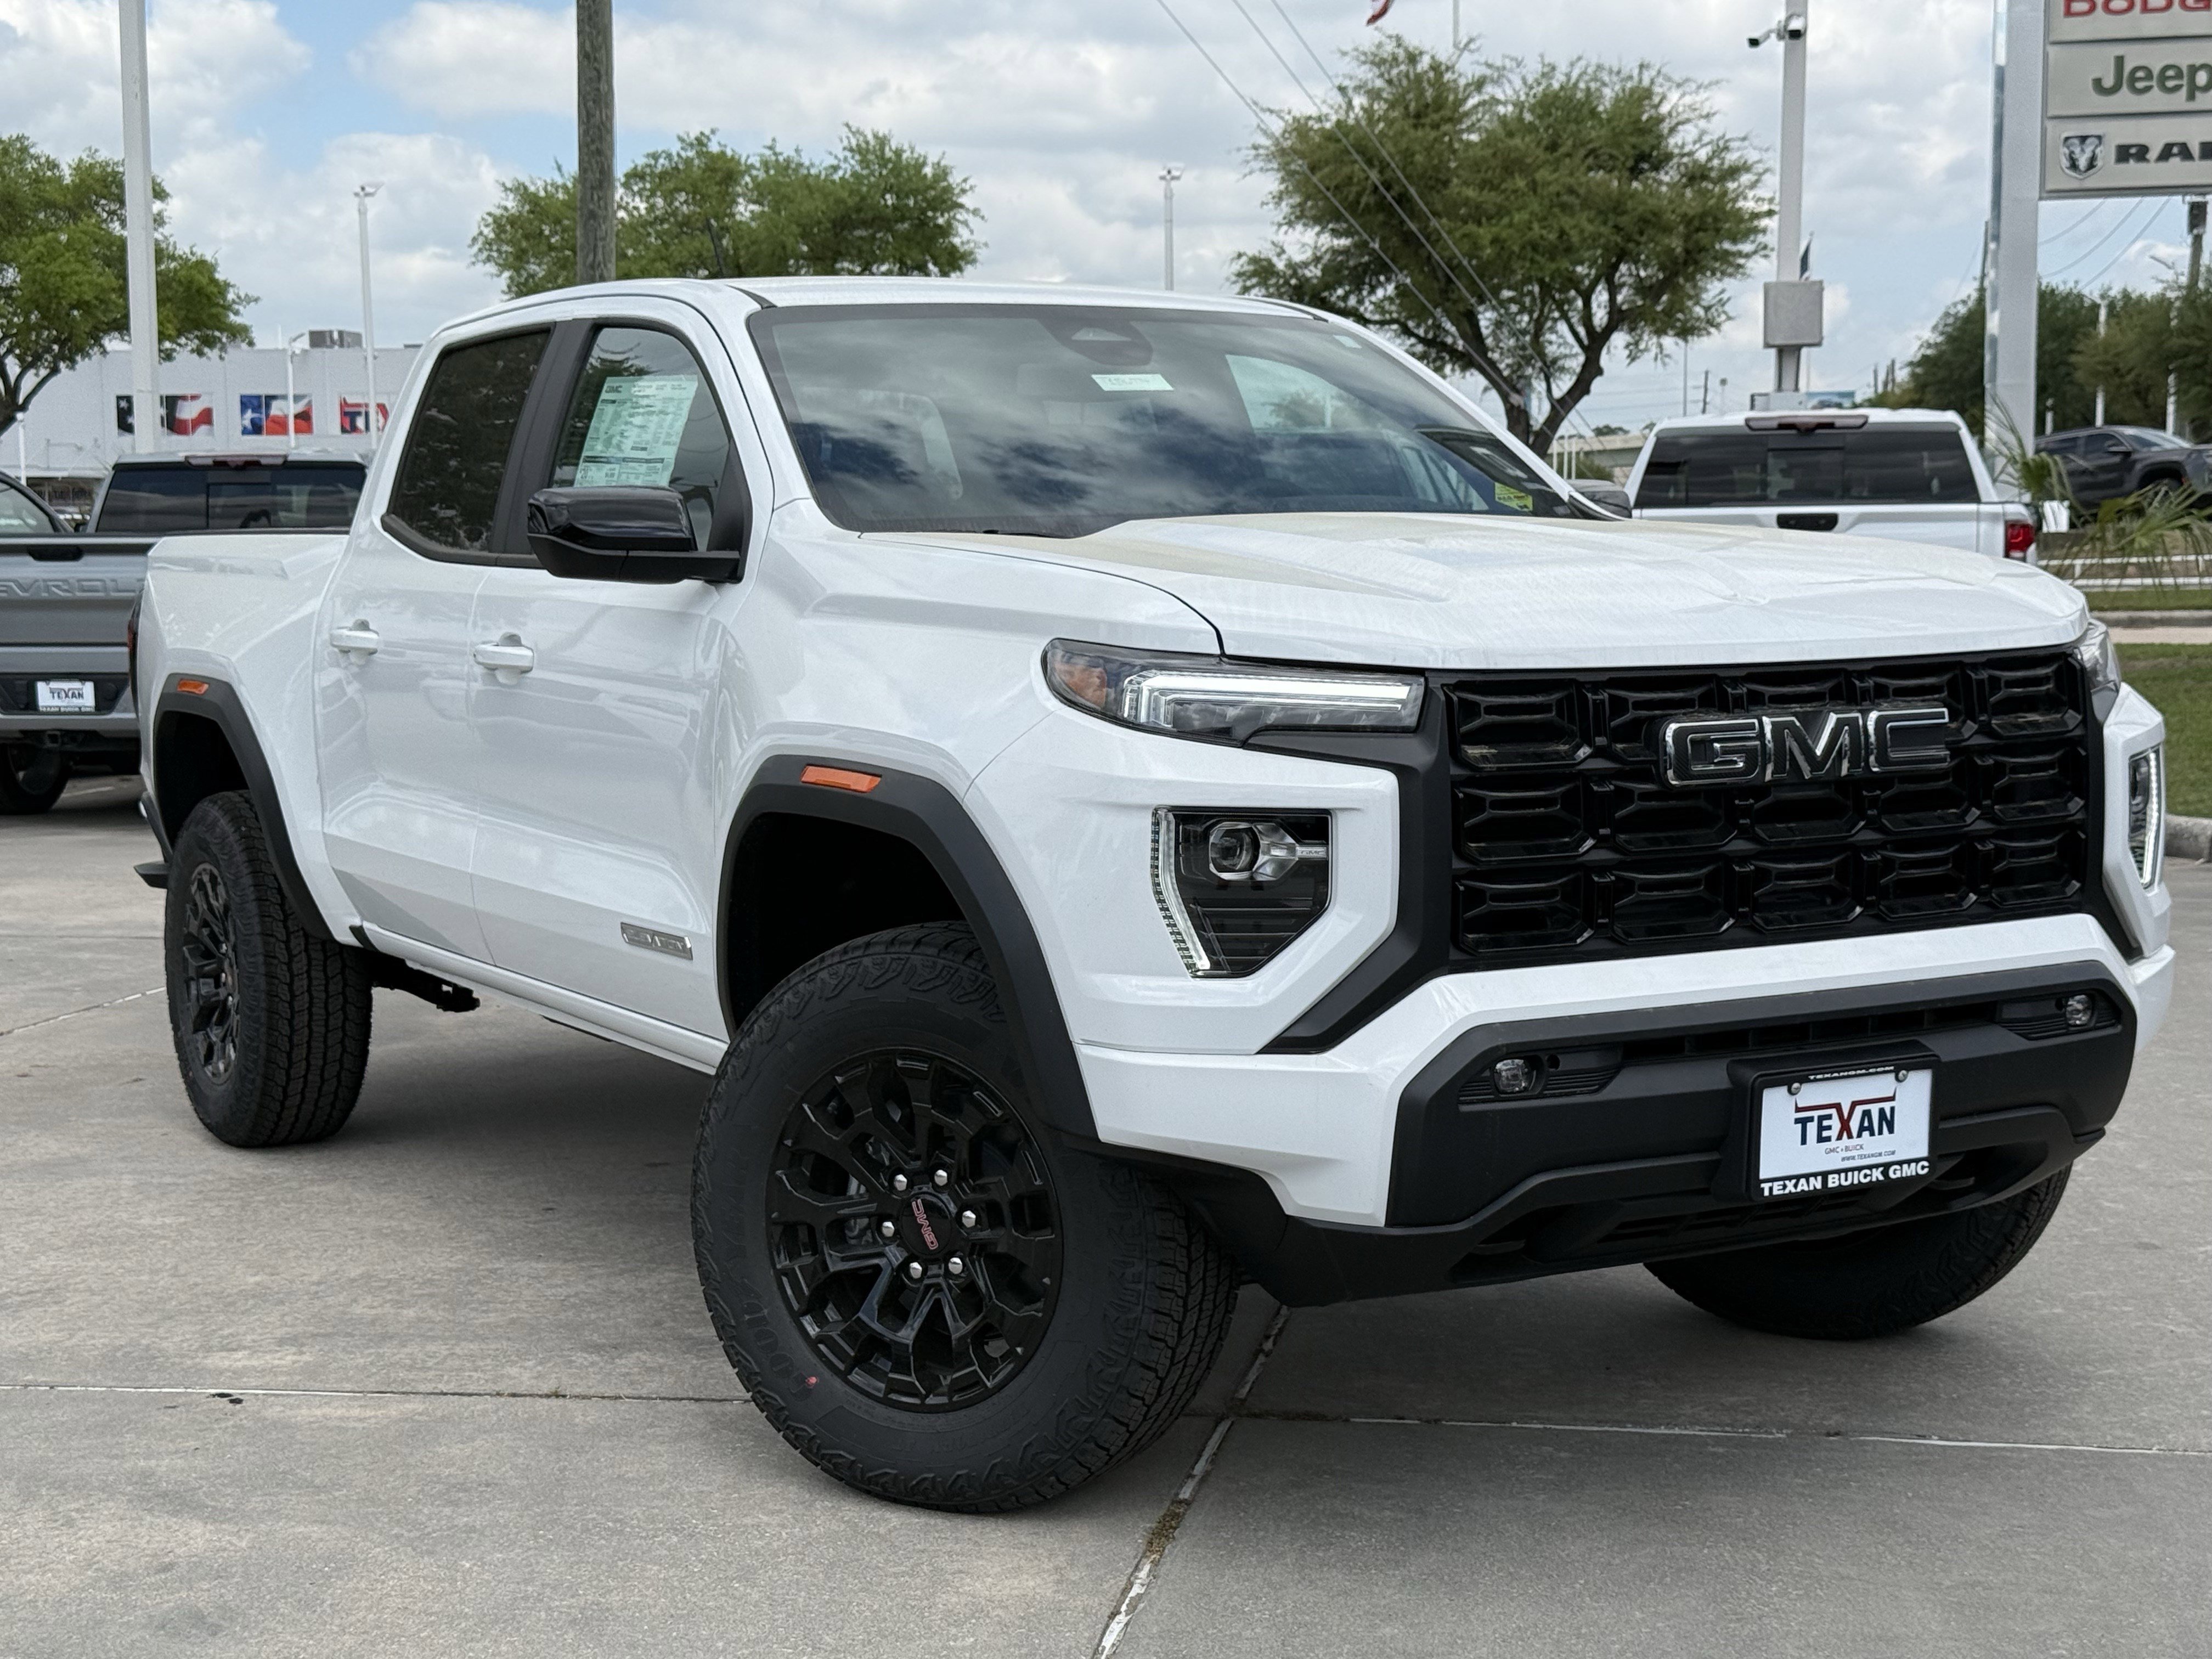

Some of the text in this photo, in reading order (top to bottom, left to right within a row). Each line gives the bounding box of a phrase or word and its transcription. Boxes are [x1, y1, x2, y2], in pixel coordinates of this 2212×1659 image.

[2091, 55, 2212, 102] Jeep
[49, 687, 84, 700] TEXAN
[1666, 708, 1950, 786] GMC
[1794, 1094, 1897, 1146] TEXAN
[1824, 1143, 1864, 1155] GMC BUICK
[1760, 1160, 1929, 1197] TEXAN BUICK GMC
[911, 1198, 939, 1250] GMC
